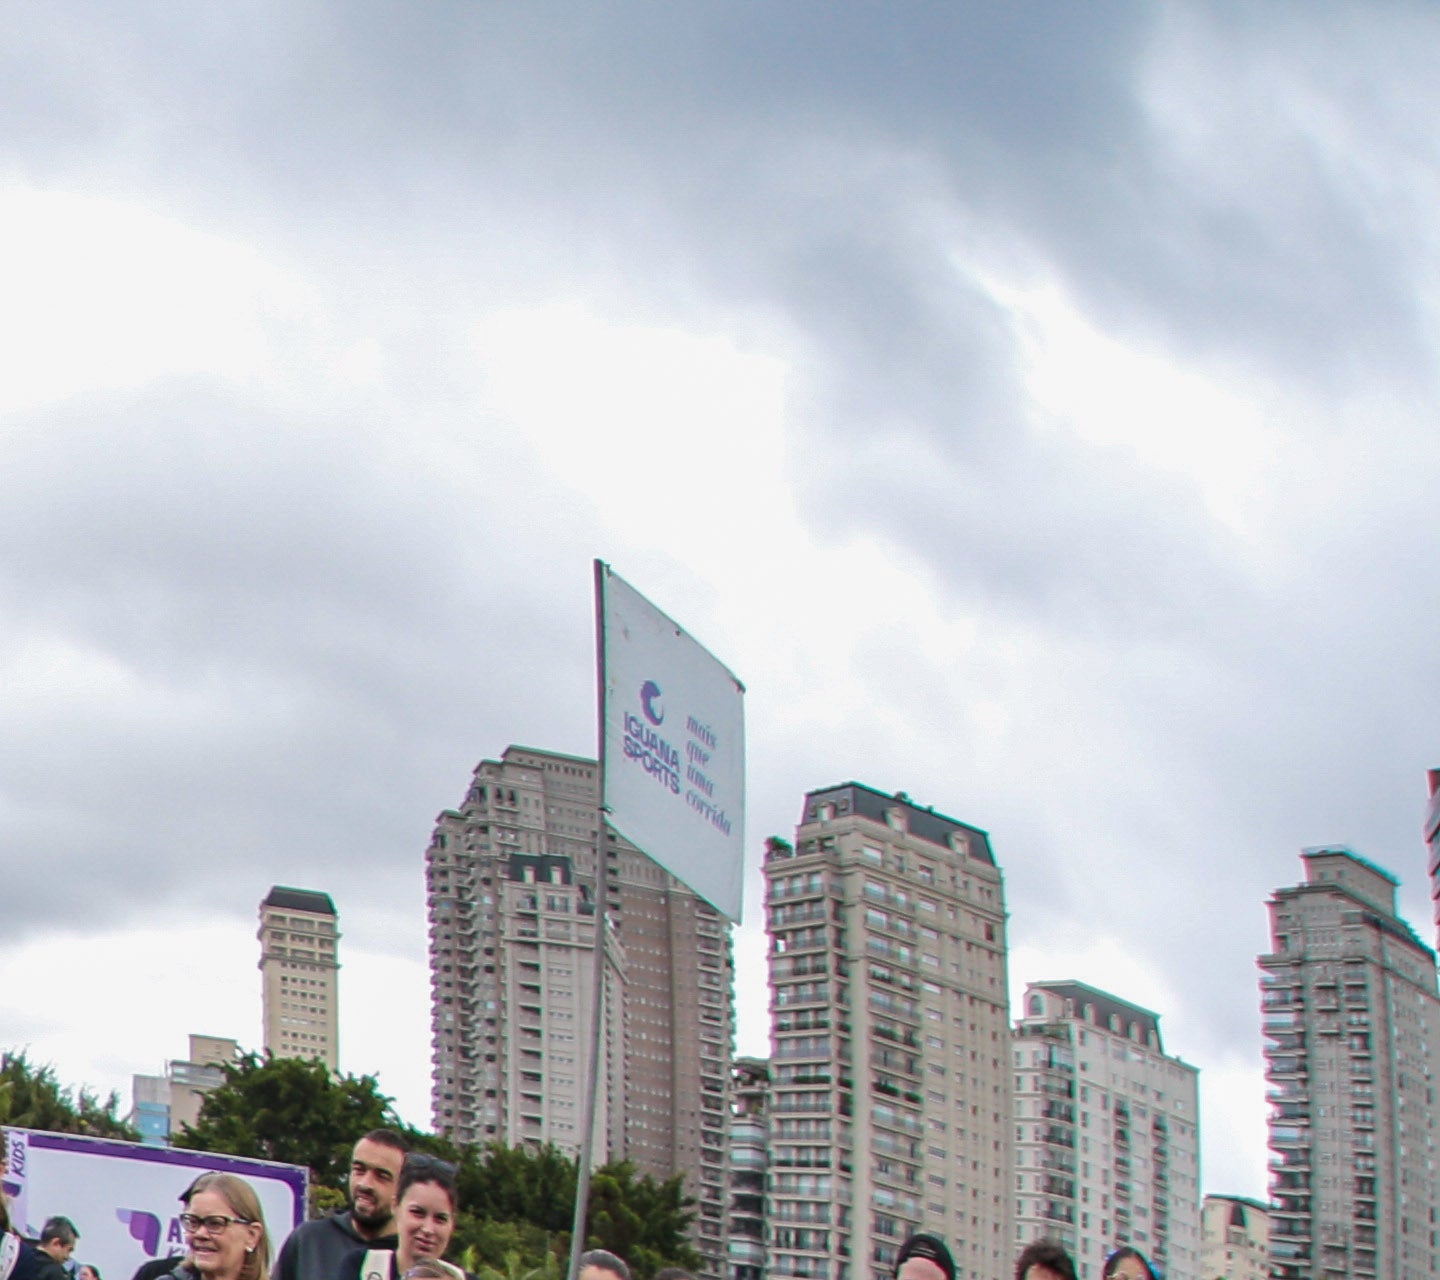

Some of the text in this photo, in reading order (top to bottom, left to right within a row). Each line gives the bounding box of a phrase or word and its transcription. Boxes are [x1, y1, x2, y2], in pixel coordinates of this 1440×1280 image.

[624, 711, 680, 773] IGUANA
[686, 715, 716, 750] mais
[623, 735, 681, 795] SPORTS
[685, 790, 732, 837] corrida
